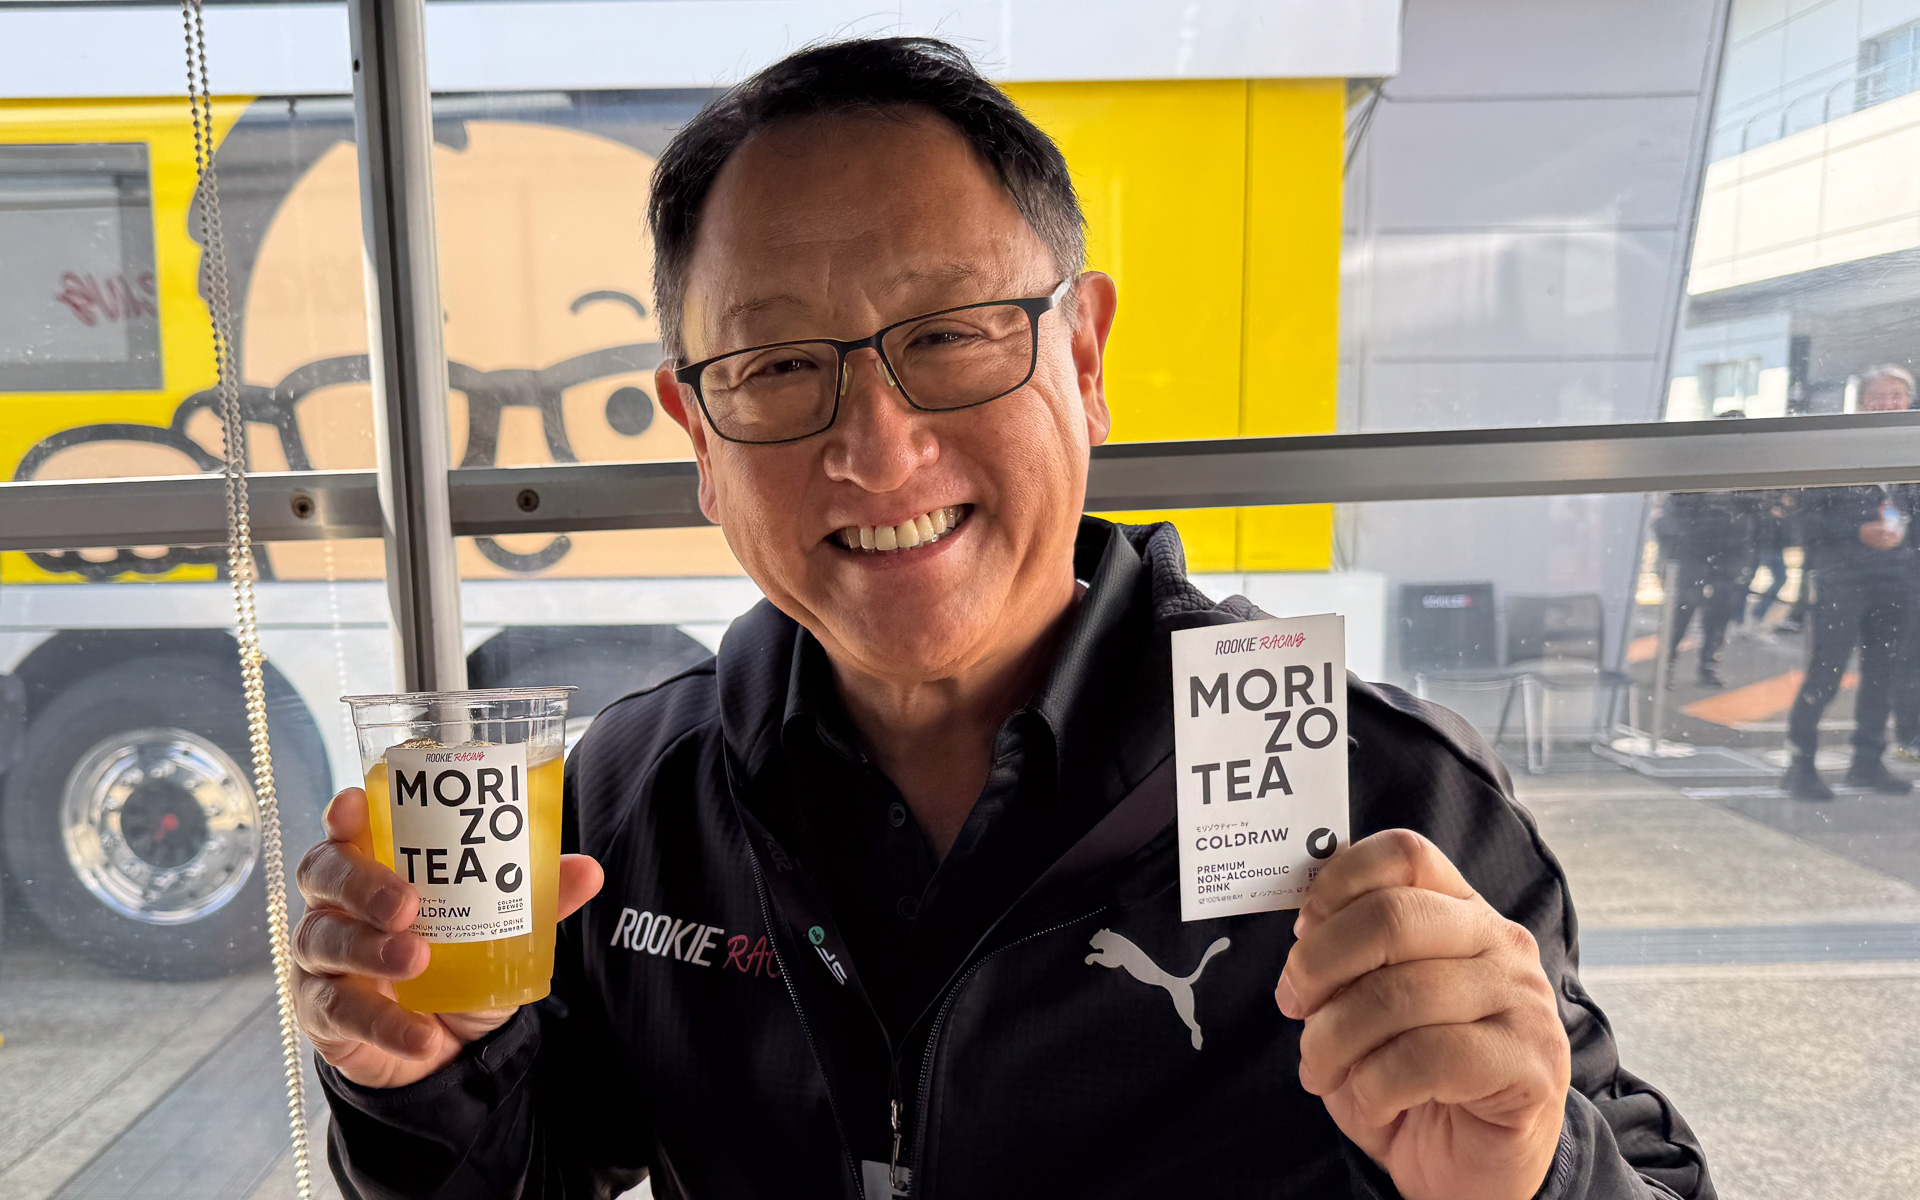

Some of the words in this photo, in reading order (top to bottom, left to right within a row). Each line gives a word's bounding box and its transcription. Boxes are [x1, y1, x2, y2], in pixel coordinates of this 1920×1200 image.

[1215, 637, 1257, 655] ROOKIE
[1259, 632, 1306, 650] RACING
[1189, 662, 1333, 717] MORI
[1264, 707, 1338, 753] ZO
[425, 753, 453, 763] ROOKIE
[453, 751, 485, 762] RACING
[395, 765, 519, 807] MORI
[1191, 756, 1293, 805] TEA
[459, 804, 523, 845] ZO
[1196, 823, 1237, 833] モリゾウティー
[1195, 827, 1289, 851] COLDRAW
[400, 847, 487, 885] TEA
[1197, 861, 1245, 874] PREMIUM
[1197, 865, 1290, 884] NON-ALCOHOLIC
[1198, 882, 1231, 894] DRINK
[417, 907, 471, 917] LDRAW
[497, 902, 524, 911] BREWED
[436, 921, 500, 932] NON-ALCOHOLIC
[503, 918, 523, 927] DRINK
[610, 907, 725, 967] ROOKIE
